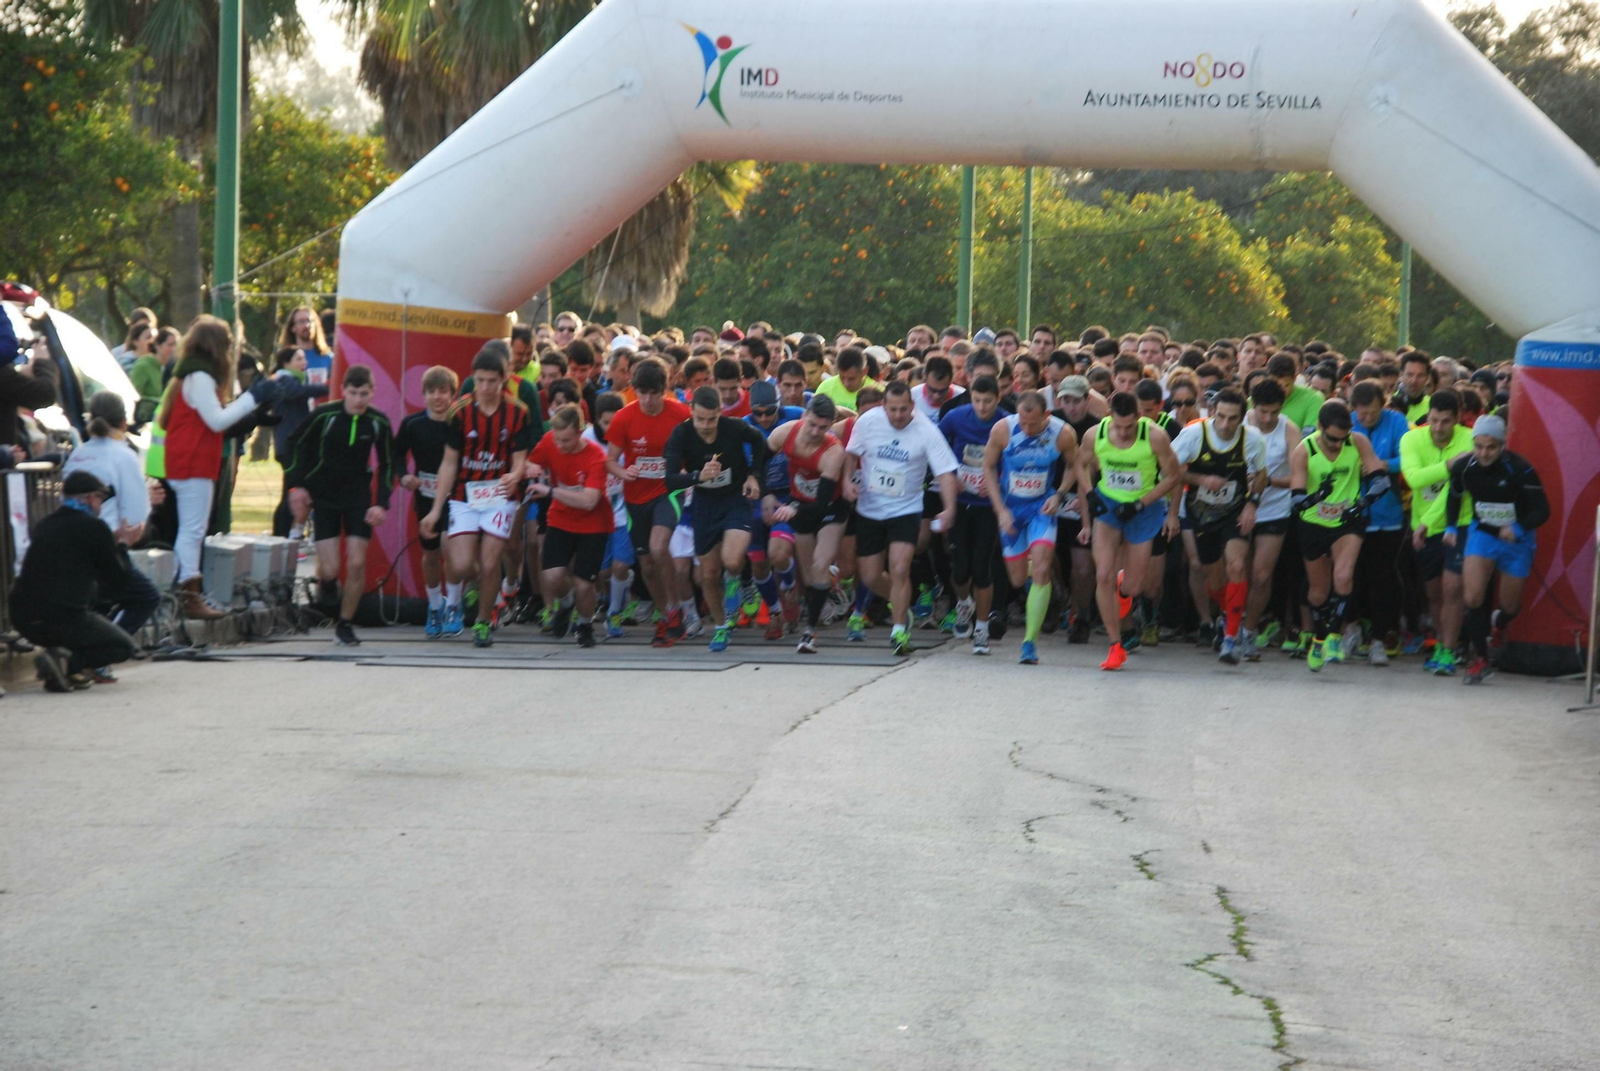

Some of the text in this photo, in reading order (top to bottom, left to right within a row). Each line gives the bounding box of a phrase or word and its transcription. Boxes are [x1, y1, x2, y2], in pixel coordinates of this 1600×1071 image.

[740, 68, 779, 87] IMD
[740, 89, 904, 103] Instituto Municipal de Deportes
[345, 307, 477, 332] www.imd.sevilla.org
[879, 474, 896, 488] 10
